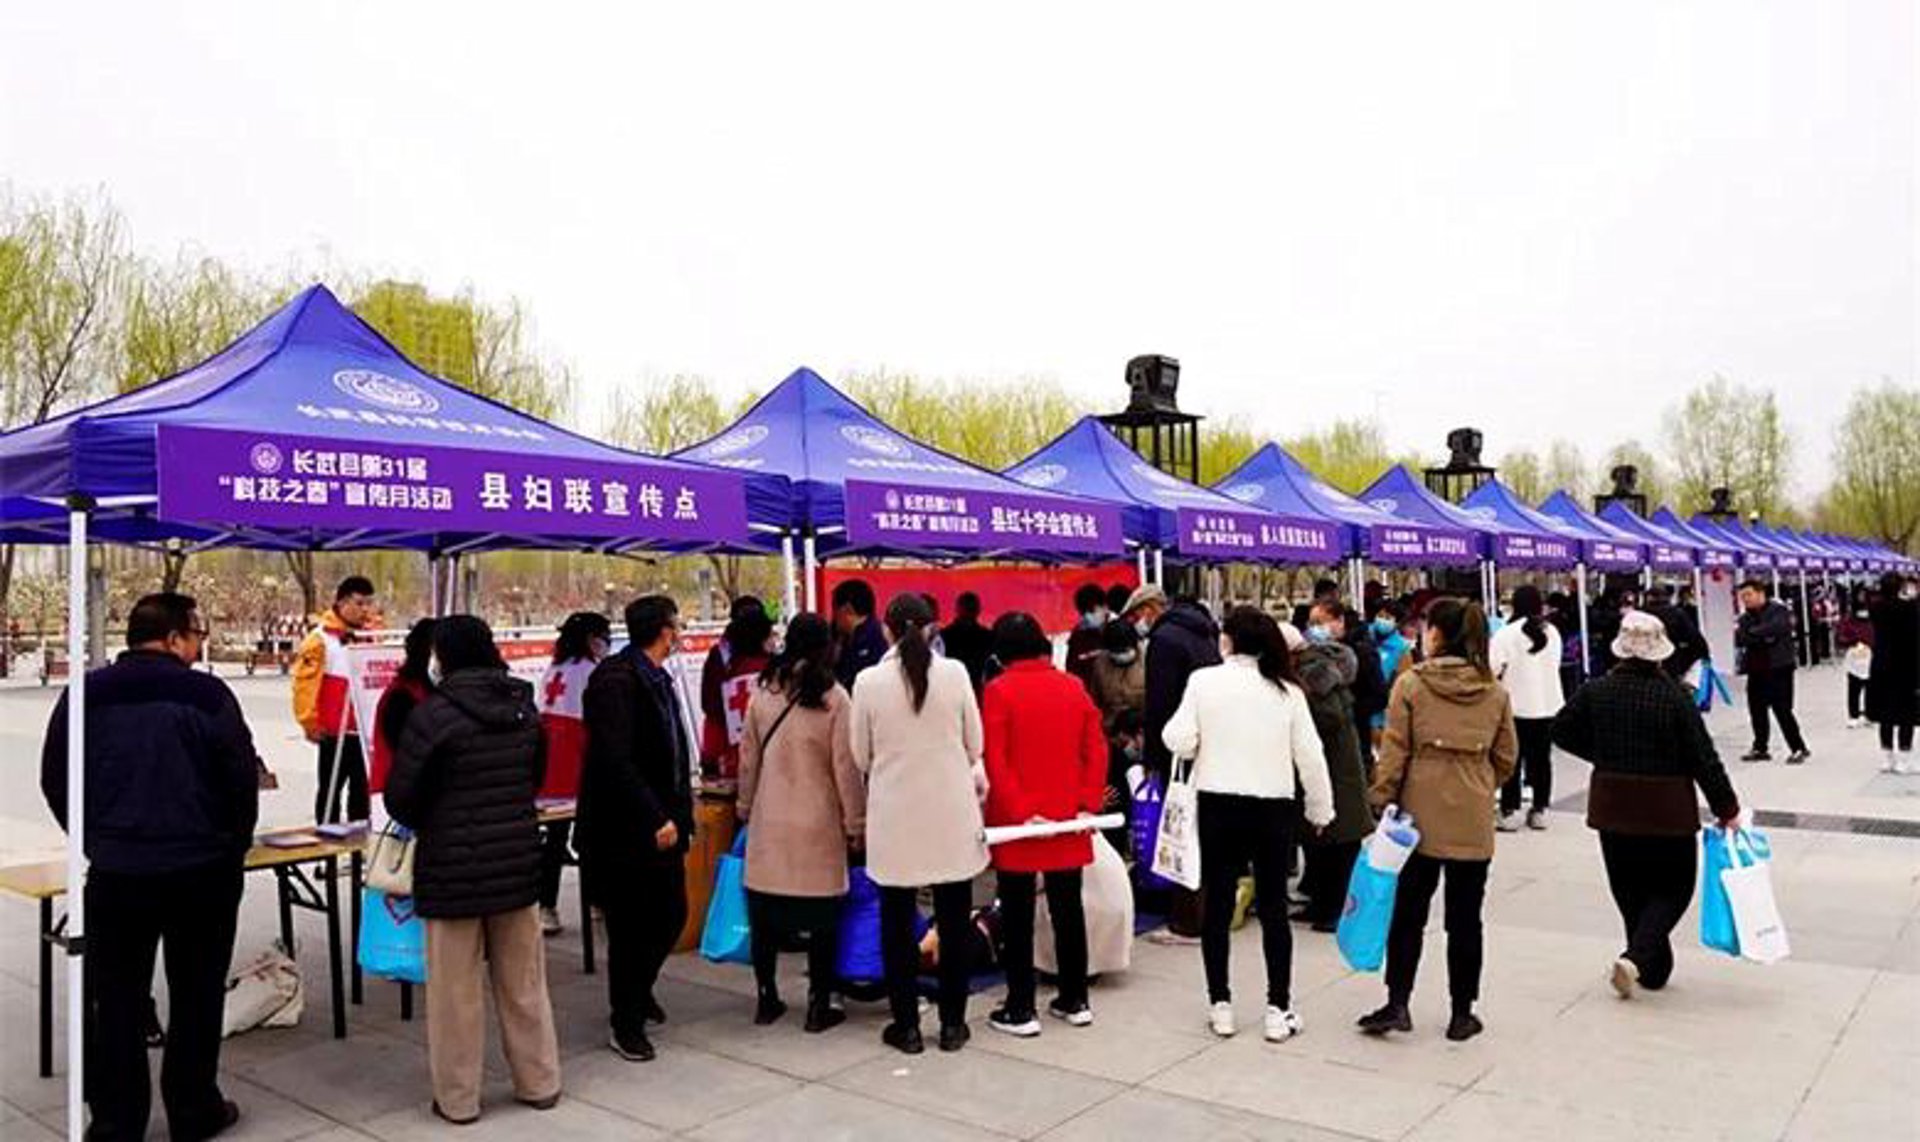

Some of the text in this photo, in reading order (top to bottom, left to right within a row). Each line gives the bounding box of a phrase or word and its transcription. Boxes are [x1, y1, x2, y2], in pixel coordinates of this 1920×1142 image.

[292, 449, 427, 481] 长武县第31届
[479, 472, 698, 520] 县妇联宣传点
[990, 506, 1099, 538] 县红十字会宣传点
